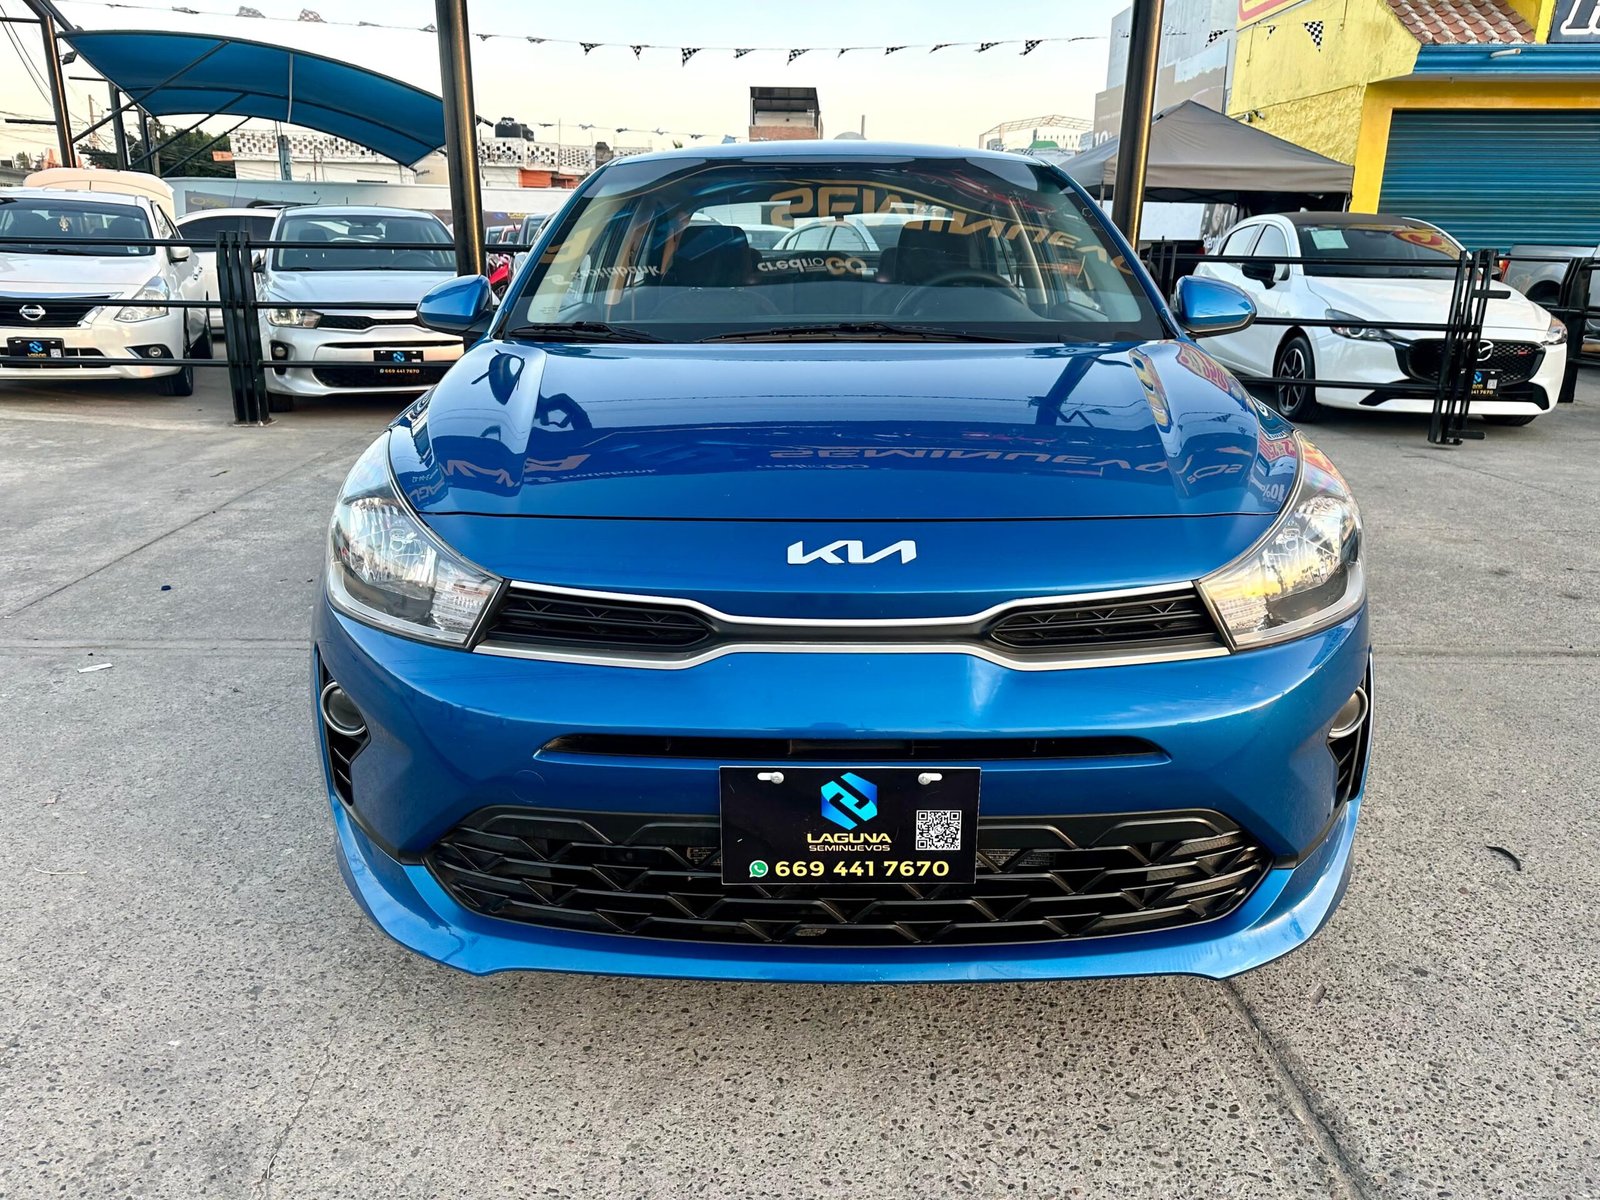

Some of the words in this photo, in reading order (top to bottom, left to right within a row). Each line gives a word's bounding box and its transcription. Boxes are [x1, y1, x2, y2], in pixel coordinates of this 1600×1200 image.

[787, 540, 917, 564] KIA
[806, 832, 892, 844] LAGUNA
[808, 844, 891, 852] SEMINUEVOS
[774, 860, 826, 877] 669
[833, 860, 875, 877] 441
[884, 860, 950, 877] 7670
